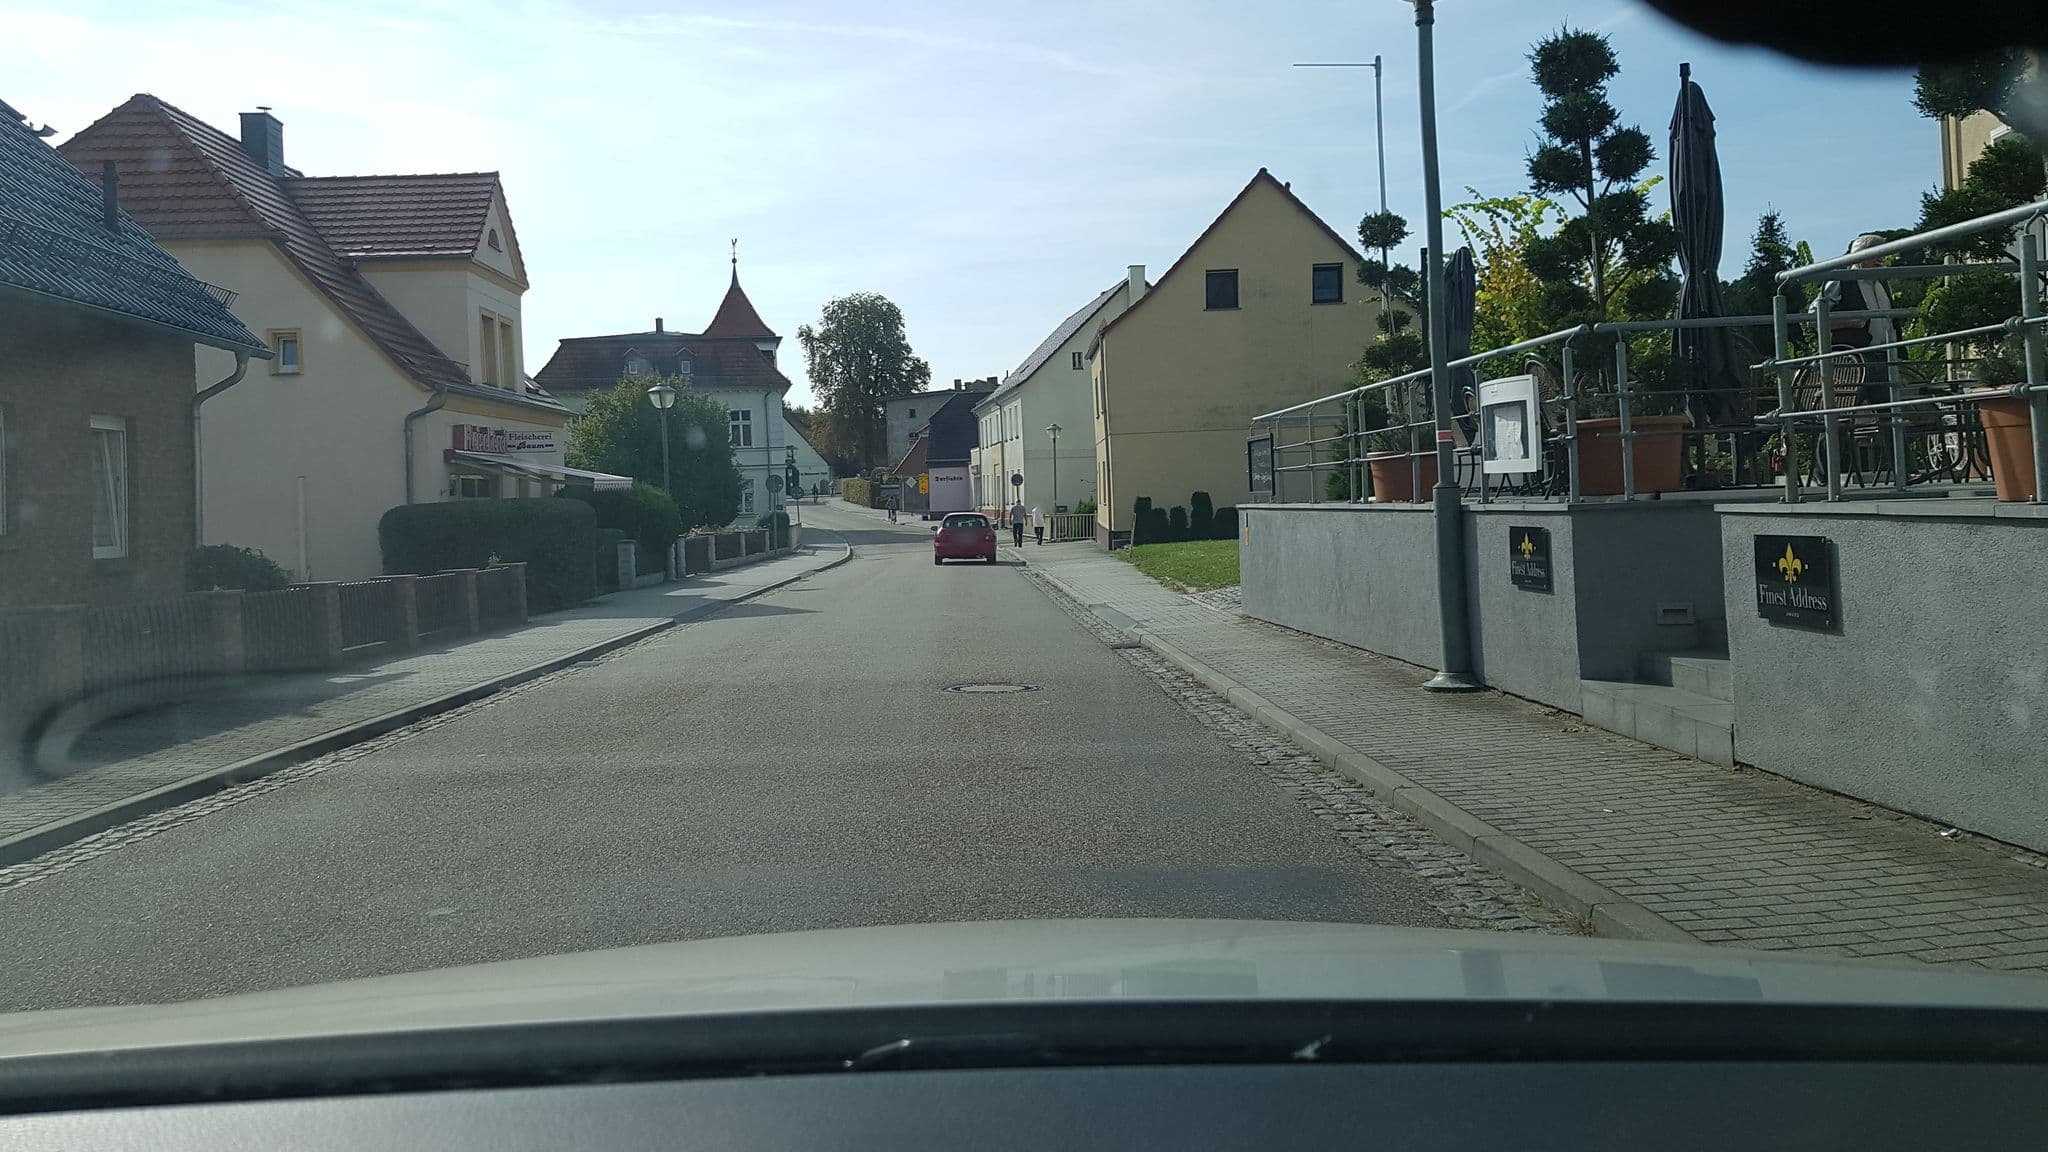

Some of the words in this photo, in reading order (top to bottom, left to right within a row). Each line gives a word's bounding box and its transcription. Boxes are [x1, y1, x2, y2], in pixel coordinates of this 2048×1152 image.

[508, 432, 552, 441] Fleischerei
[1759, 583, 1787, 606] Finest
[1789, 586, 1828, 611] Address
